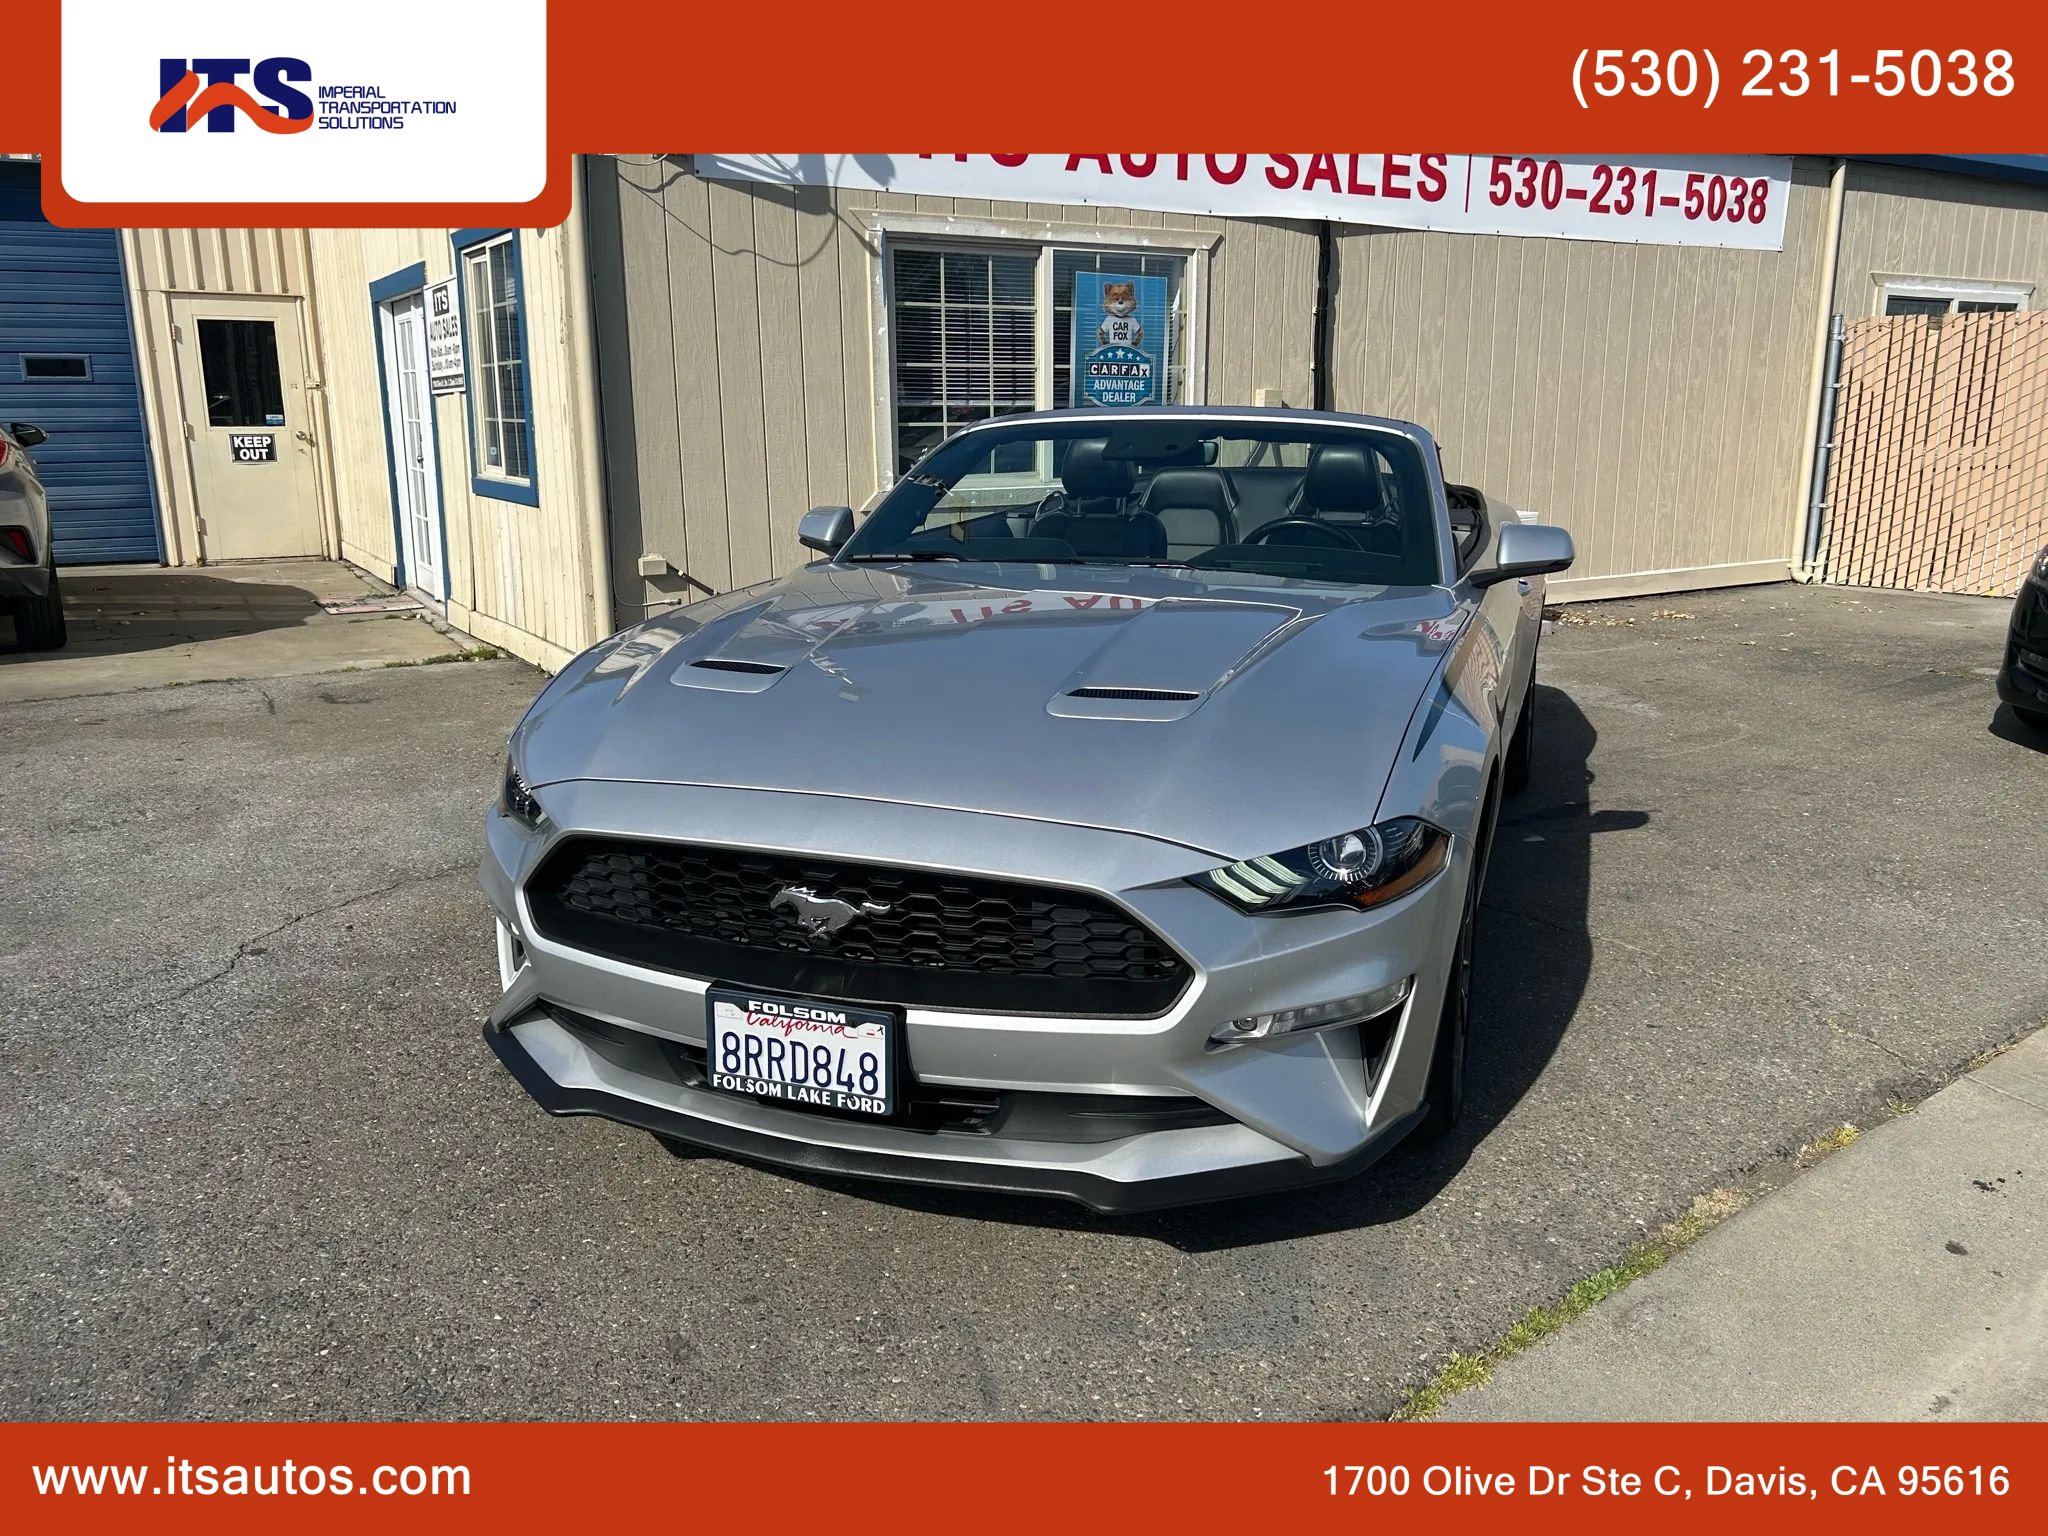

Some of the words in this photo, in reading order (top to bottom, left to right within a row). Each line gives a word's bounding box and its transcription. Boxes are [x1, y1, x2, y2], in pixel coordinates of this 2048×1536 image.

[1264, 153, 1448, 203] SALES
[1488, 154, 1769, 225] 530-231-5038
[433, 290, 448, 312] ITS
[1112, 322, 1129, 331] CAR
[1113, 331, 1129, 341] FOX
[1090, 364, 1149, 377] CARFAX
[1093, 379, 1145, 391] ADVANTAGE
[1102, 391, 1136, 403] DEALER
[233, 436, 271, 448] KEEP
[239, 448, 269, 461] OUT
[748, 1000, 846, 1024] FOLSOM
[746, 1011, 859, 1039] California
[722, 1031, 879, 1096] 8RRD848
[712, 1073, 782, 1098] FOLSOM
[787, 1085, 832, 1106] LAKE
[837, 1093, 886, 1114] FORD
